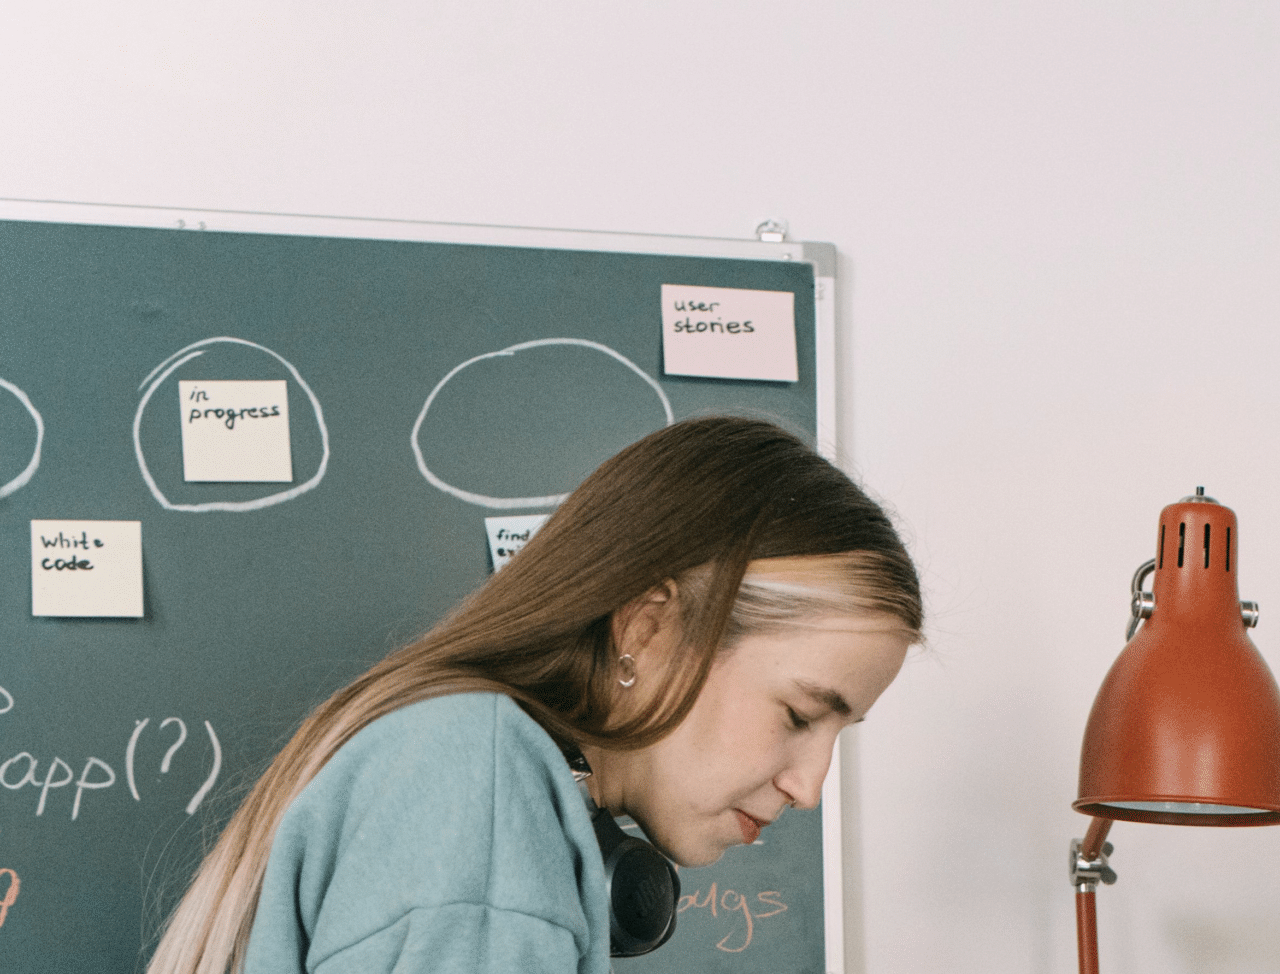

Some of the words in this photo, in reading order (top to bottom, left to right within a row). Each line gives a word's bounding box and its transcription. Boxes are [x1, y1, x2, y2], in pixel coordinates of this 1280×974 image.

[674, 299, 720, 312] user
[673, 316, 756, 334] stories
[189, 386, 210, 403] in
[189, 404, 281, 430] progress
[41, 531, 105, 550] white
[496, 528, 530, 542] find
[41, 554, 94, 572] code
